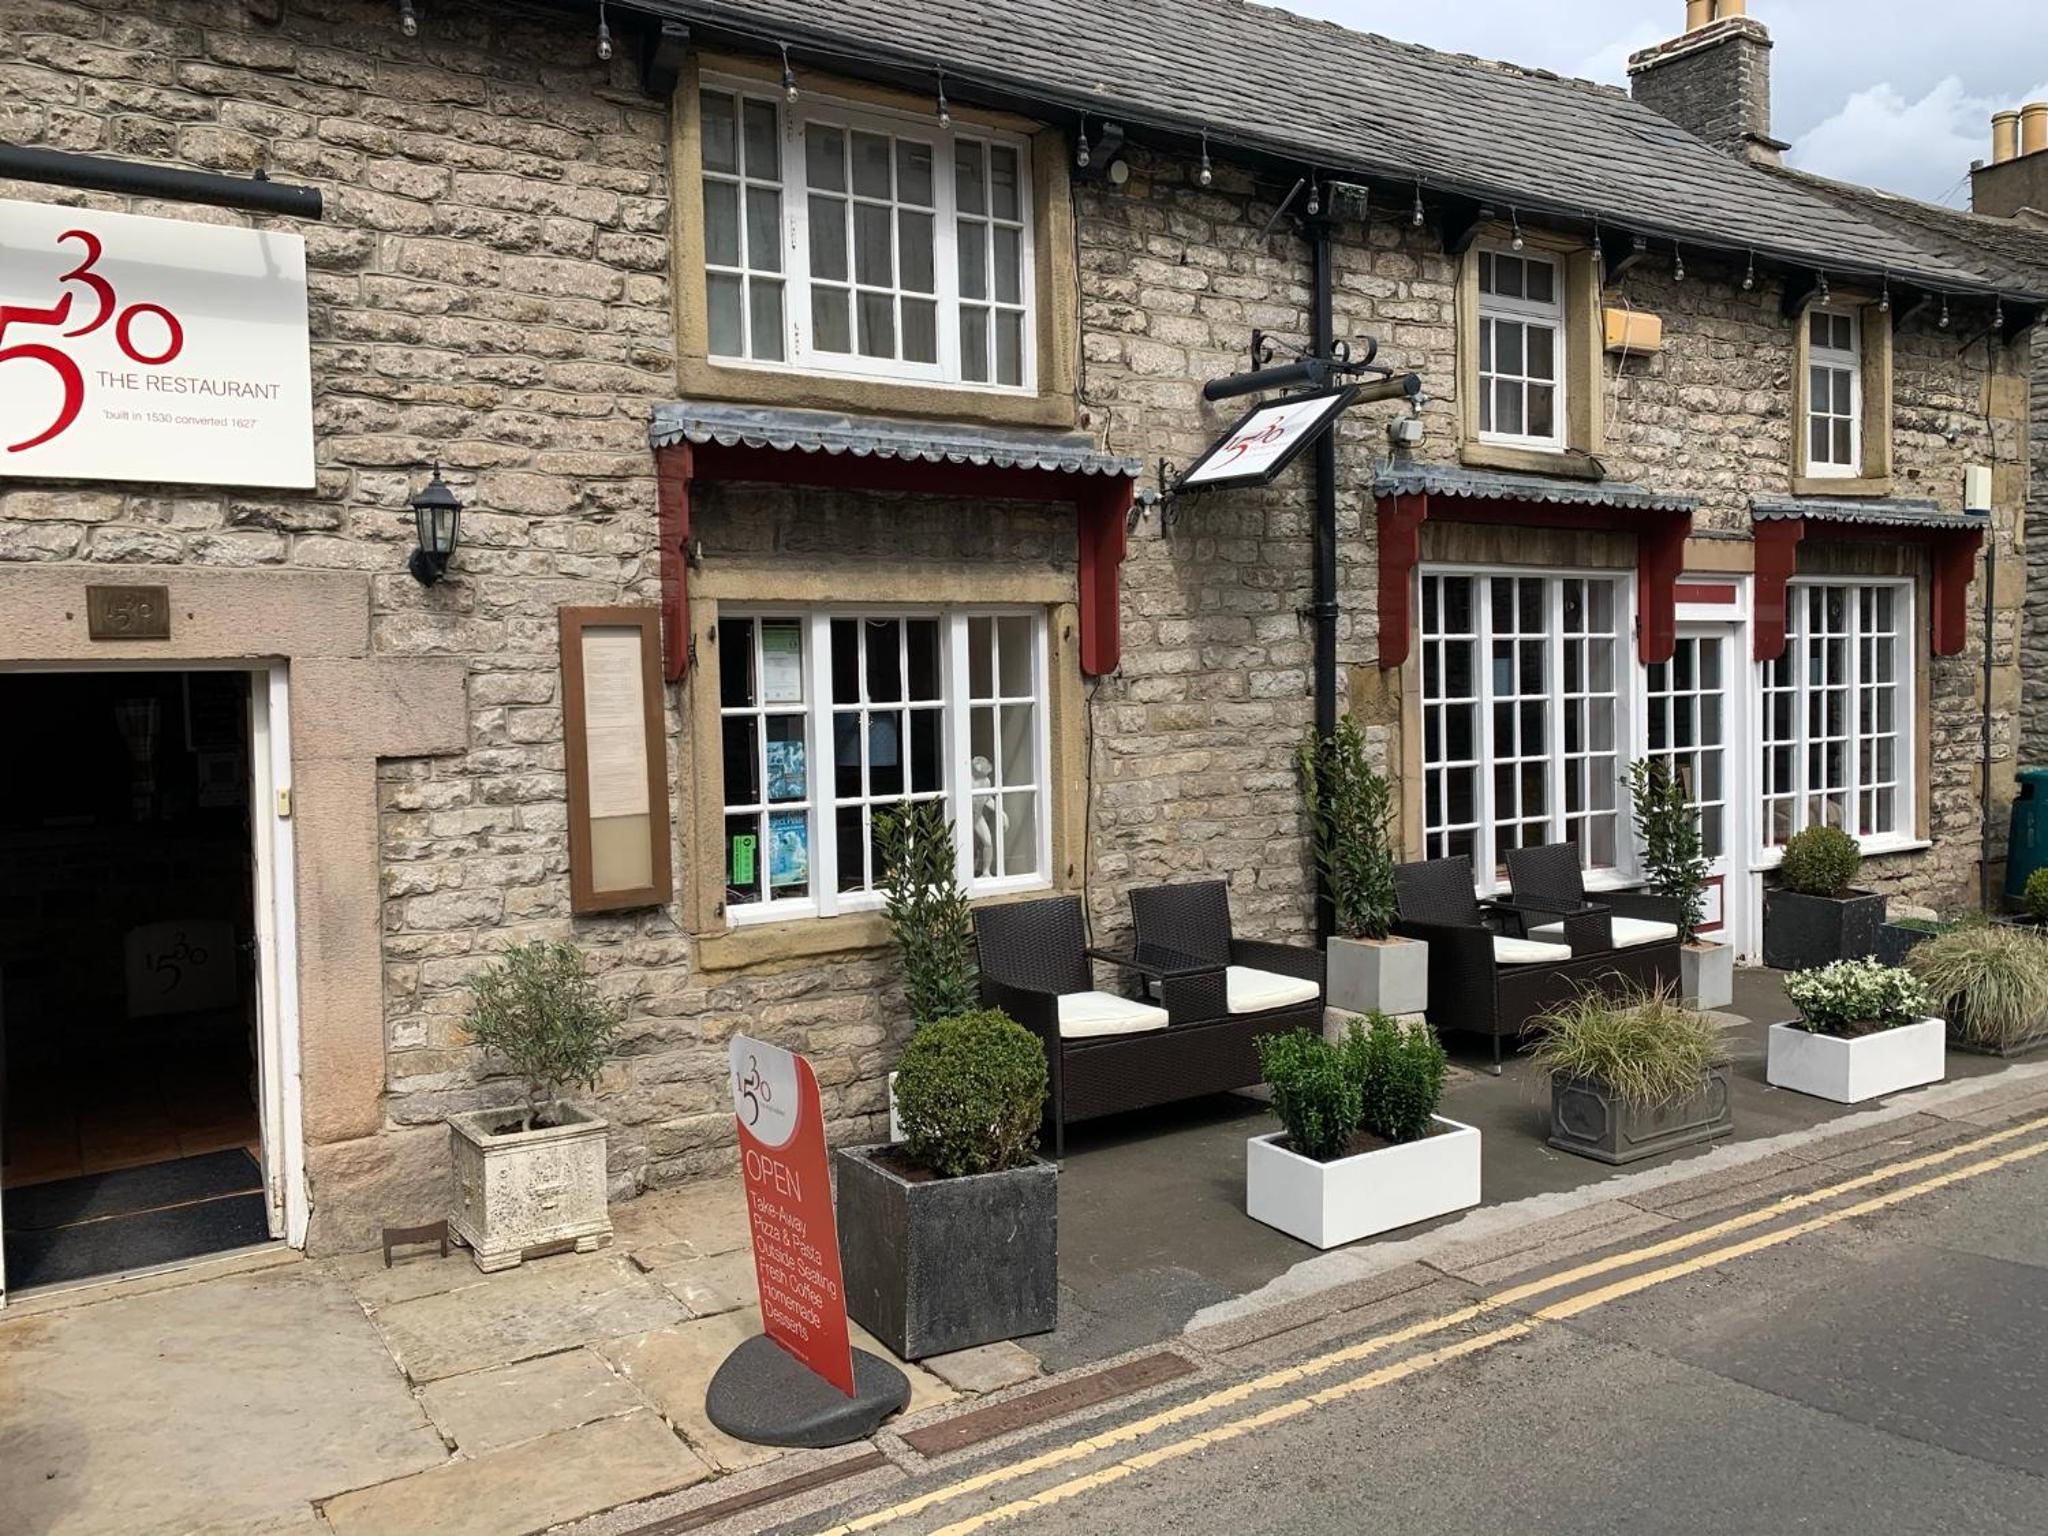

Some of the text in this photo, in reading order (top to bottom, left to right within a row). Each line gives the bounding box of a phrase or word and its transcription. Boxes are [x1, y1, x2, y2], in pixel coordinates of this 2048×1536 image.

[96, 371, 280, 400] THE RESTAURANT
[132, 411, 142, 421] in
[146, 412, 172, 424] 1530
[175, 415, 228, 427] converted
[144, 926, 208, 994] 1530
[736, 1055, 772, 1126] 1530
[746, 1149, 802, 1202] OPEN
[750, 1190, 807, 1239] Take-Away
[753, 1213, 823, 1266] Pizza & Pasta
[756, 1235, 837, 1300] Outside Seating
[759, 1256, 823, 1309] Fresh Coffee
[762, 1277, 821, 1329] Homemade
[764, 1299, 809, 1341] Desserts
